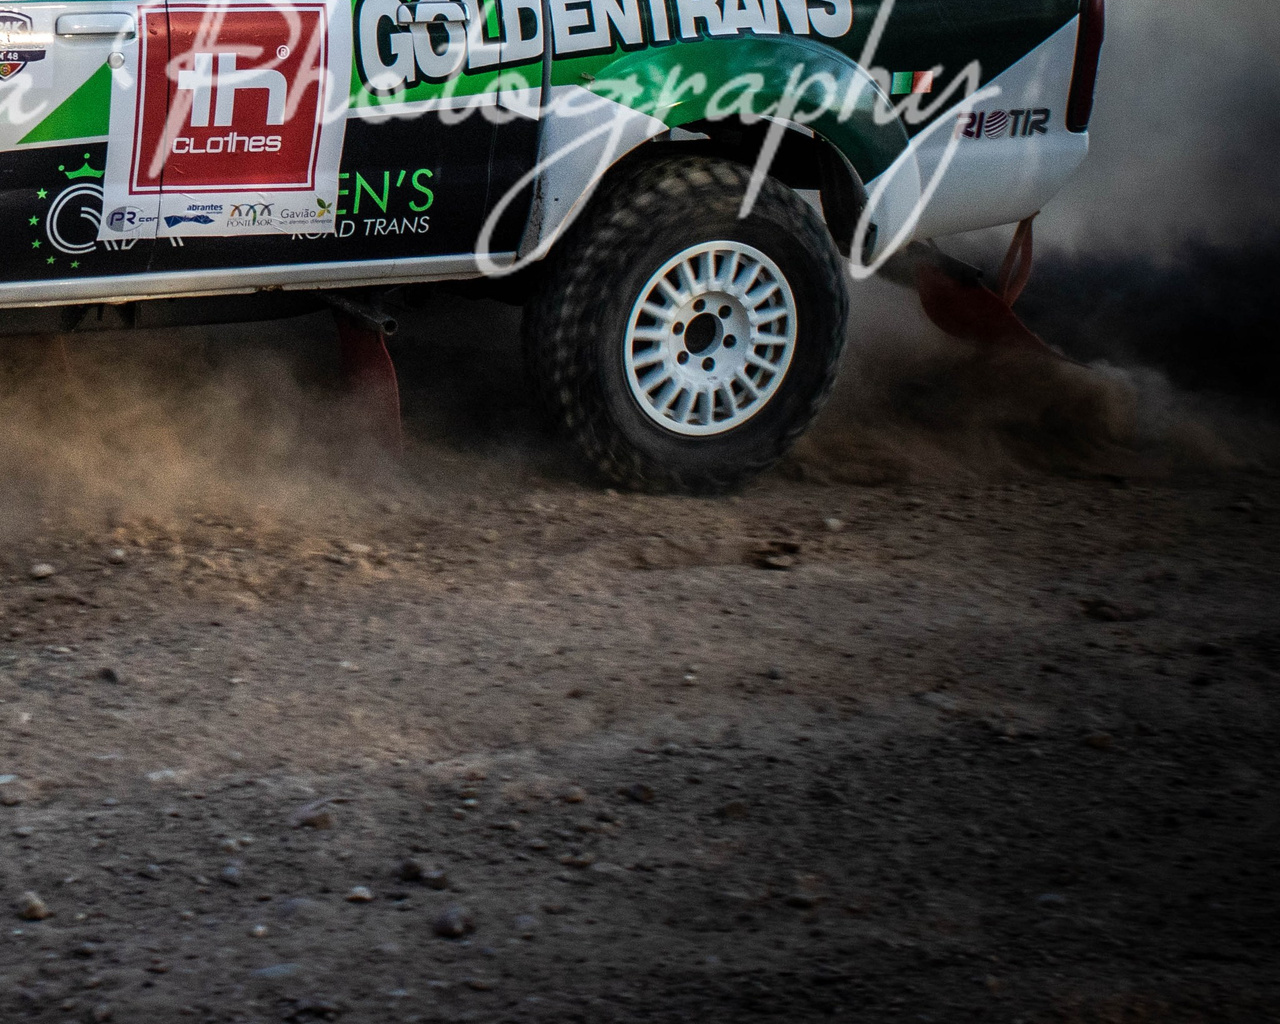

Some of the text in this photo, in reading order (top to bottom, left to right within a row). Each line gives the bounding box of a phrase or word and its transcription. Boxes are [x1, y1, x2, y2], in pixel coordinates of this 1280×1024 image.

[7, 52, 19, 61] 48
[186, 204, 223, 212] abrantes
[280, 207, 317, 219] Gavião
[363, 215, 431, 237] TRANS
